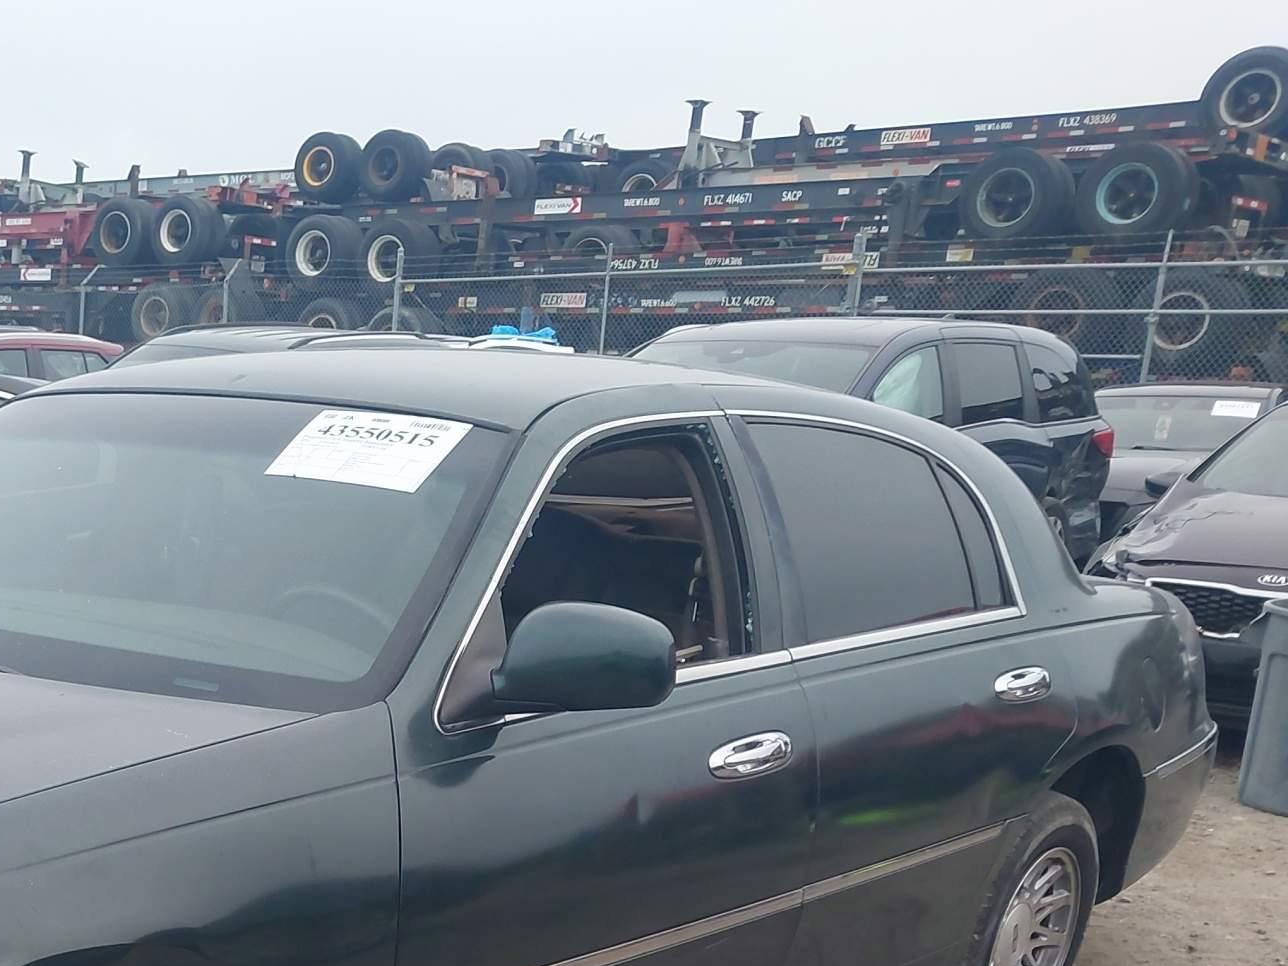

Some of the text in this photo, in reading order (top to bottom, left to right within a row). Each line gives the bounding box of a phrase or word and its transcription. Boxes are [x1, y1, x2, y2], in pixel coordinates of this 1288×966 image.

[1058, 113, 1117, 128] FLXZ 438369
[881, 129, 929, 144] FLEXI-VAN
[703, 192, 752, 206] FLXZ 414671
[781, 190, 803, 202] SACP
[720, 295, 775, 307] FLXZ 442726
[317, 423, 441, 448] 43550515
[1262, 574, 1286, 584] KIA
